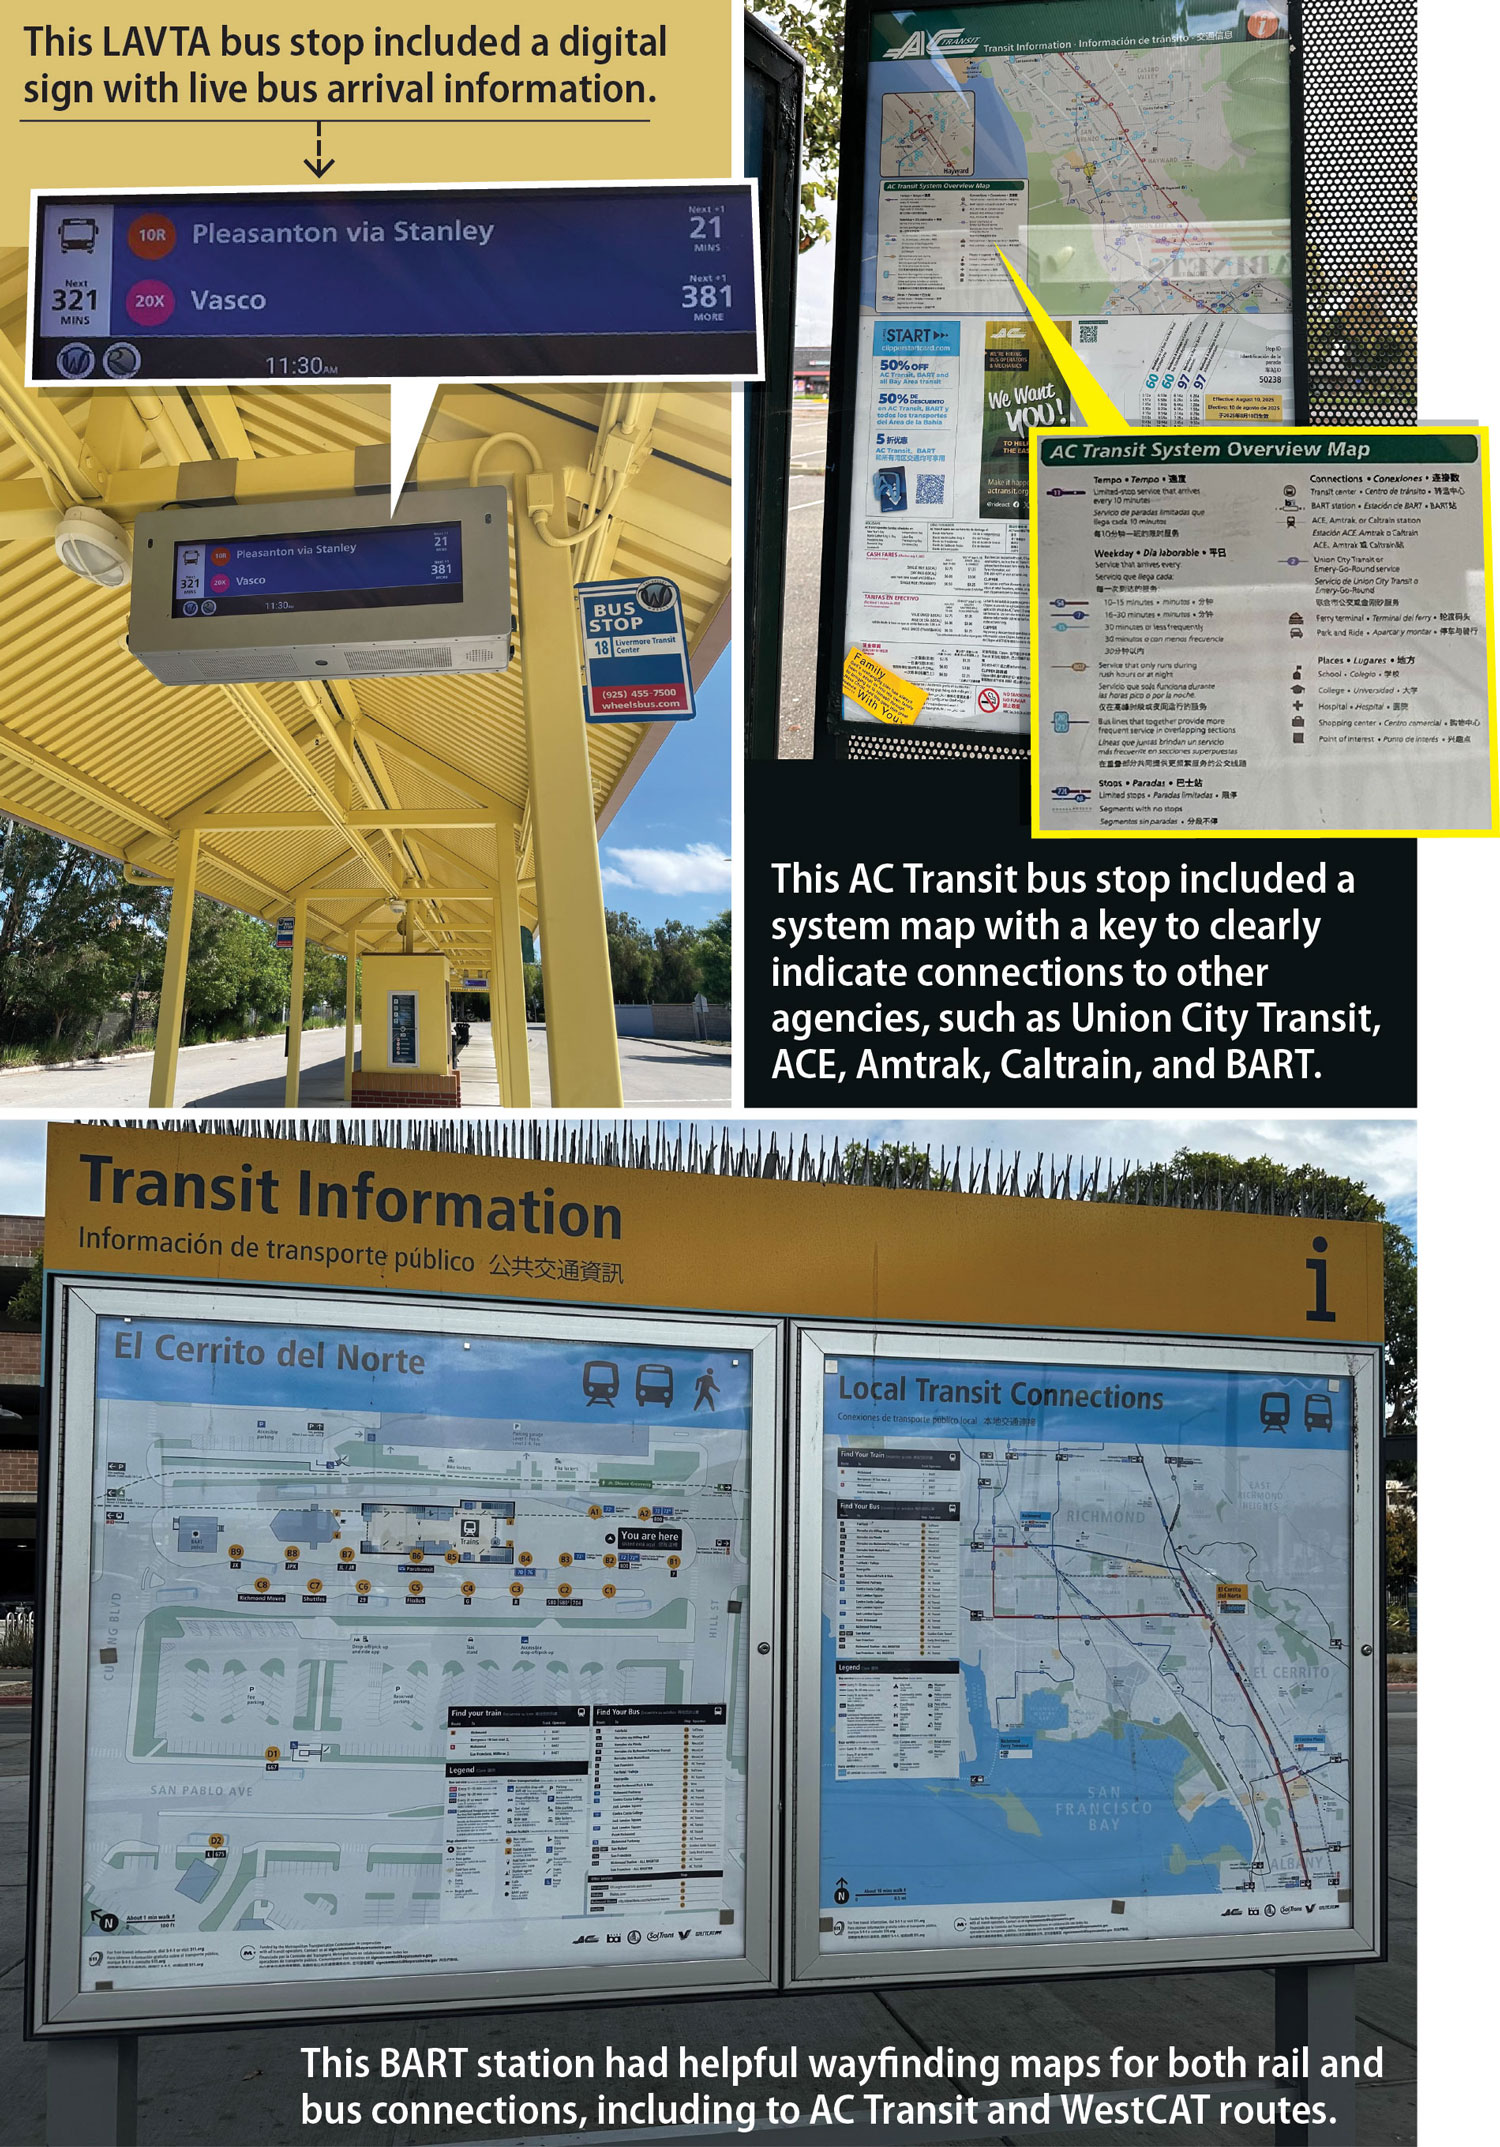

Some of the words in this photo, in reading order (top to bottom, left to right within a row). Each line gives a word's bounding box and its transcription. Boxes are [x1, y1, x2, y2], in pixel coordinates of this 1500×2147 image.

[882, 28, 979, 59] AC
[942, 37, 980, 45] TRANSIT
[984, 43, 1014, 53] Transit
[1017, 41, 1071, 51] Information
[1079, 36, 1136, 47] Información
[1138, 36, 1150, 44] de
[1152, 34, 1189, 44] tránsito
[139, 229, 166, 241] 10R
[193, 223, 337, 244] Pleasanton
[347, 221, 385, 242] via
[394, 219, 495, 245] Stanley
[689, 216, 721, 239] 21
[694, 244, 721, 252] MINS
[65, 279, 88, 288] Next
[690, 274, 713, 282] Next
[51, 289, 98, 311] 321
[135, 295, 165, 307] 20X
[190, 289, 267, 310] Vasco
[681, 285, 732, 308] 381
[60, 315, 90, 325] MINS
[694, 313, 724, 321] MORE
[887, 329, 931, 342] START
[882, 345, 950, 353] clipperstartcard.com
[880, 360, 910, 371] 50%
[1259, 376, 1282, 384] 50238
[988, 390, 1011, 410] We
[1014, 383, 1055, 405] Want
[1050, 444, 1077, 458] AC
[1083, 443, 1146, 458] Transit
[1151, 442, 1220, 460] System
[1227, 441, 1322, 457] Overview
[1328, 441, 1370, 459] Map
[1310, 474, 1363, 483] Connections
[236, 548, 294, 559] Pleasanton
[297, 546, 313, 554] via
[316, 543, 356, 554] Stanley
[1095, 549, 1133, 558] Weekday
[236, 576, 266, 586] Vasco
[594, 602, 635, 617] BUS
[589, 617, 643, 632] STOP
[595, 640, 609, 655] 18
[615, 638, 650, 646] Livermore
[652, 636, 676, 644] Transit
[1318, 656, 1343, 665] Places
[1354, 657, 1386, 666] Lugares
[1318, 670, 1341, 678] School
[1350, 671, 1376, 679] Colegio
[602, 690, 627, 699] (925)
[631, 688, 676, 697] 455-7500
[602, 700, 680, 710] wheelsbus.com
[80, 1153, 279, 1214] Transit
[300, 1170, 621, 1240] Information
[79, 1226, 222, 1255] Información
[231, 1235, 258, 1257] de
[267, 1239, 387, 1269] transporte
[395, 1248, 474, 1272] público
[489, 1254, 624, 1284] 公共交通資訊
[115, 1331, 142, 1359] El
[156, 1334, 264, 1365] Cerrito
[277, 1340, 324, 1369] del
[338, 1344, 425, 1375] Norte
[839, 1375, 905, 1401] Local
[915, 1378, 1001, 1405] Transit
[1011, 1382, 1164, 1410] Connections
[1067, 1510, 1145, 1523] RICHMOND
[622, 1531, 639, 1540] You
[659, 1532, 678, 1541] here
[1254, 1667, 1268, 1678] EL
[1273, 1666, 1329, 1679] CERRITO
[449, 1766, 474, 1775] Legend
[1088, 1786, 1120, 1799] SAN
[1056, 1802, 1152, 1815] FRANCISCO
[1089, 1819, 1120, 1831] BAY
[1271, 1856, 1323, 1870] ALBANY
